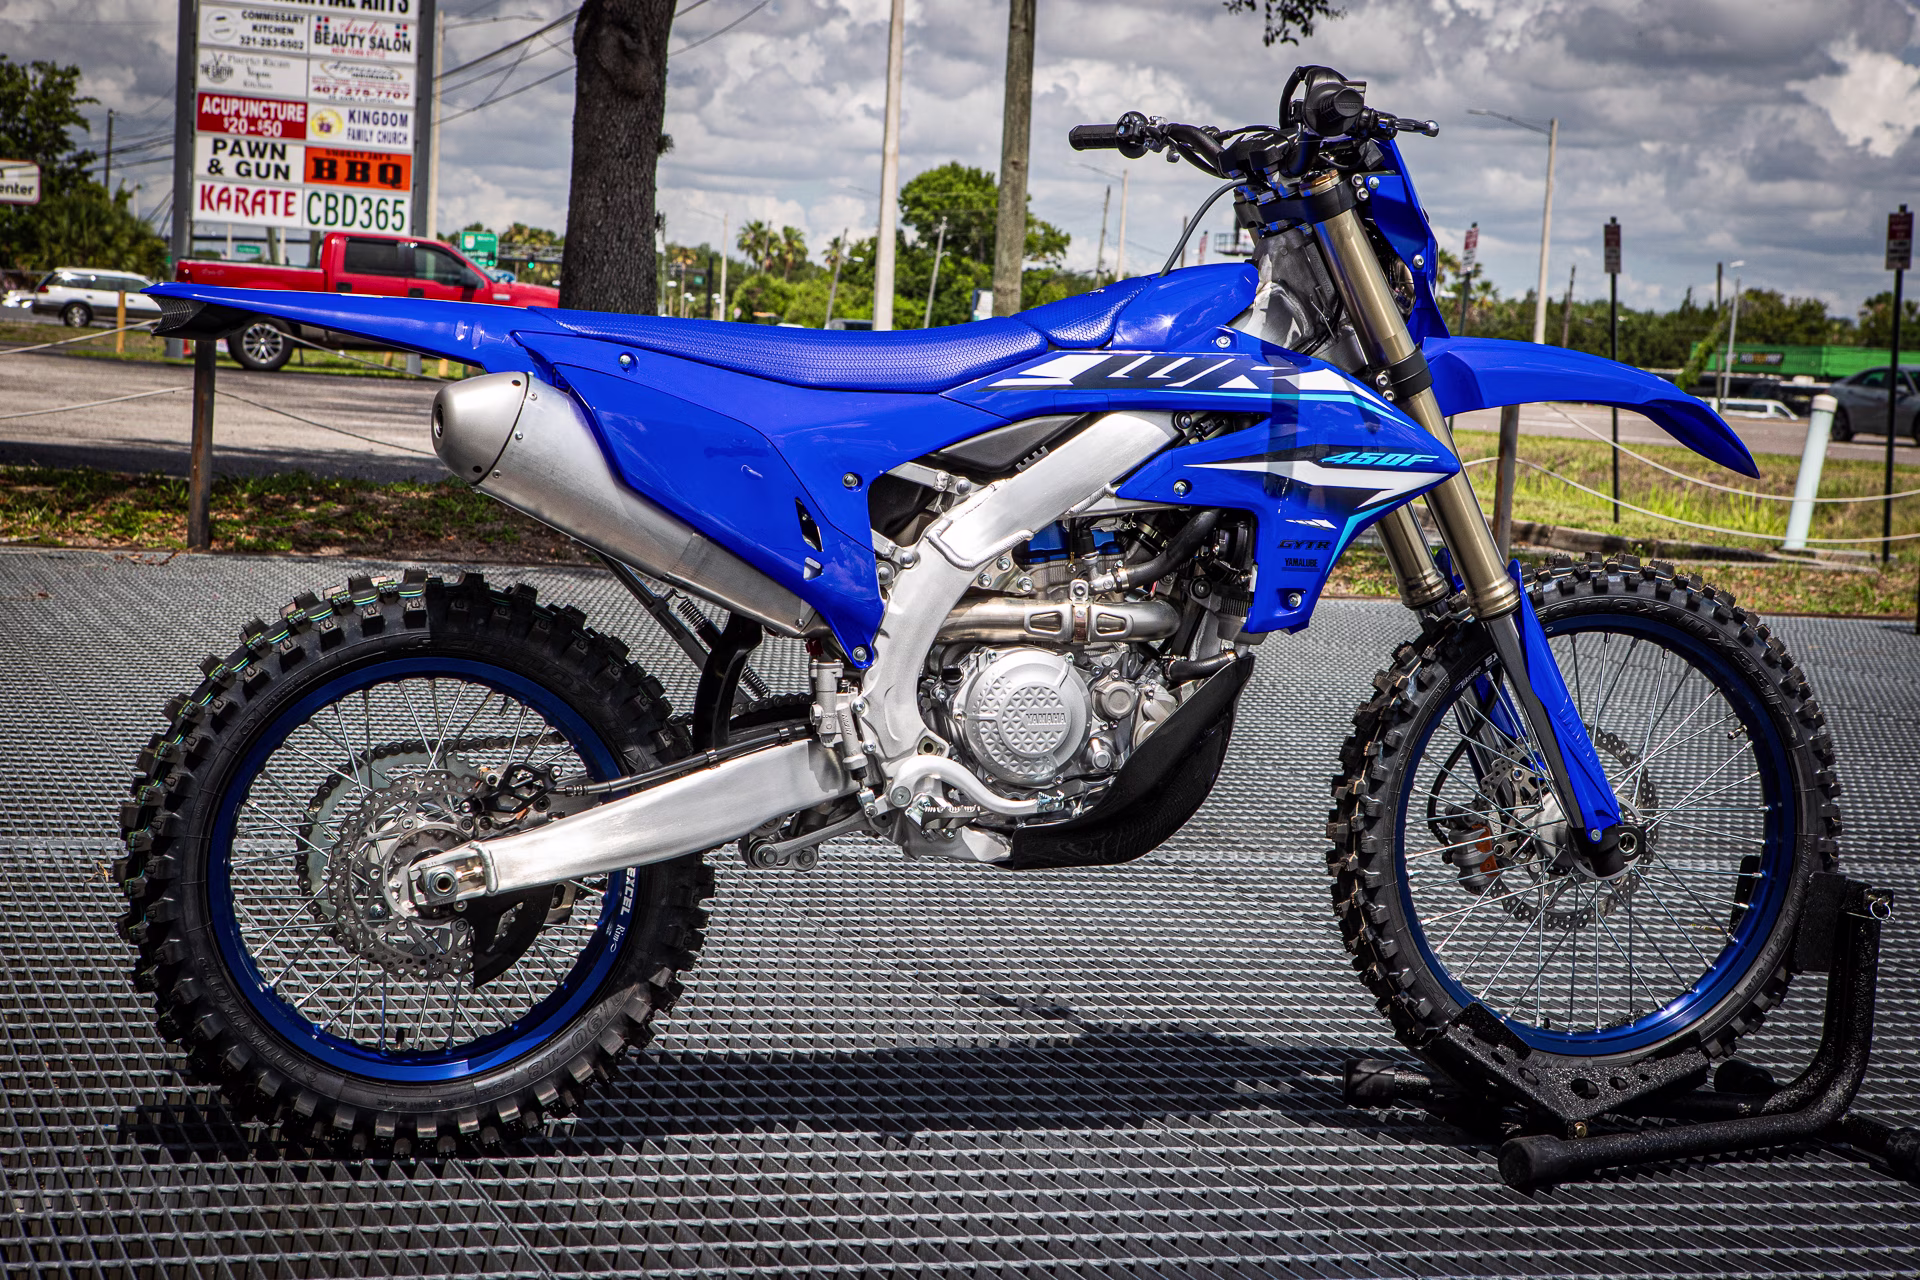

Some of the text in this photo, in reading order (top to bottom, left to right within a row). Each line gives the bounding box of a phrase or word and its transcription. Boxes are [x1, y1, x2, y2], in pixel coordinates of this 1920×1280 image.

[241, 9, 304, 24] COMMISSARY
[252, 24, 294, 35] KITCHEN
[315, 31, 411, 53] BEAUTY SALON
[202, 96, 305, 122] ACUPUNCTURE
[348, 109, 408, 127] KINGDOM
[347, 127, 408, 145] FAMILY CHURCH
[213, 138, 286, 161] PAWN
[207, 158, 290, 181] & GUN
[0, 182, 34, 195] enter
[200, 184, 297, 217] KARATE
[306, 191, 405, 231] CBD365
[1318, 451, 1440, 467] 450F
[1276, 539, 1332, 551] GYTR
[1285, 557, 1319, 568] YAMALUBE
[1025, 712, 1067, 725] YAMAHA
[619, 867, 637, 916] EXCEL
